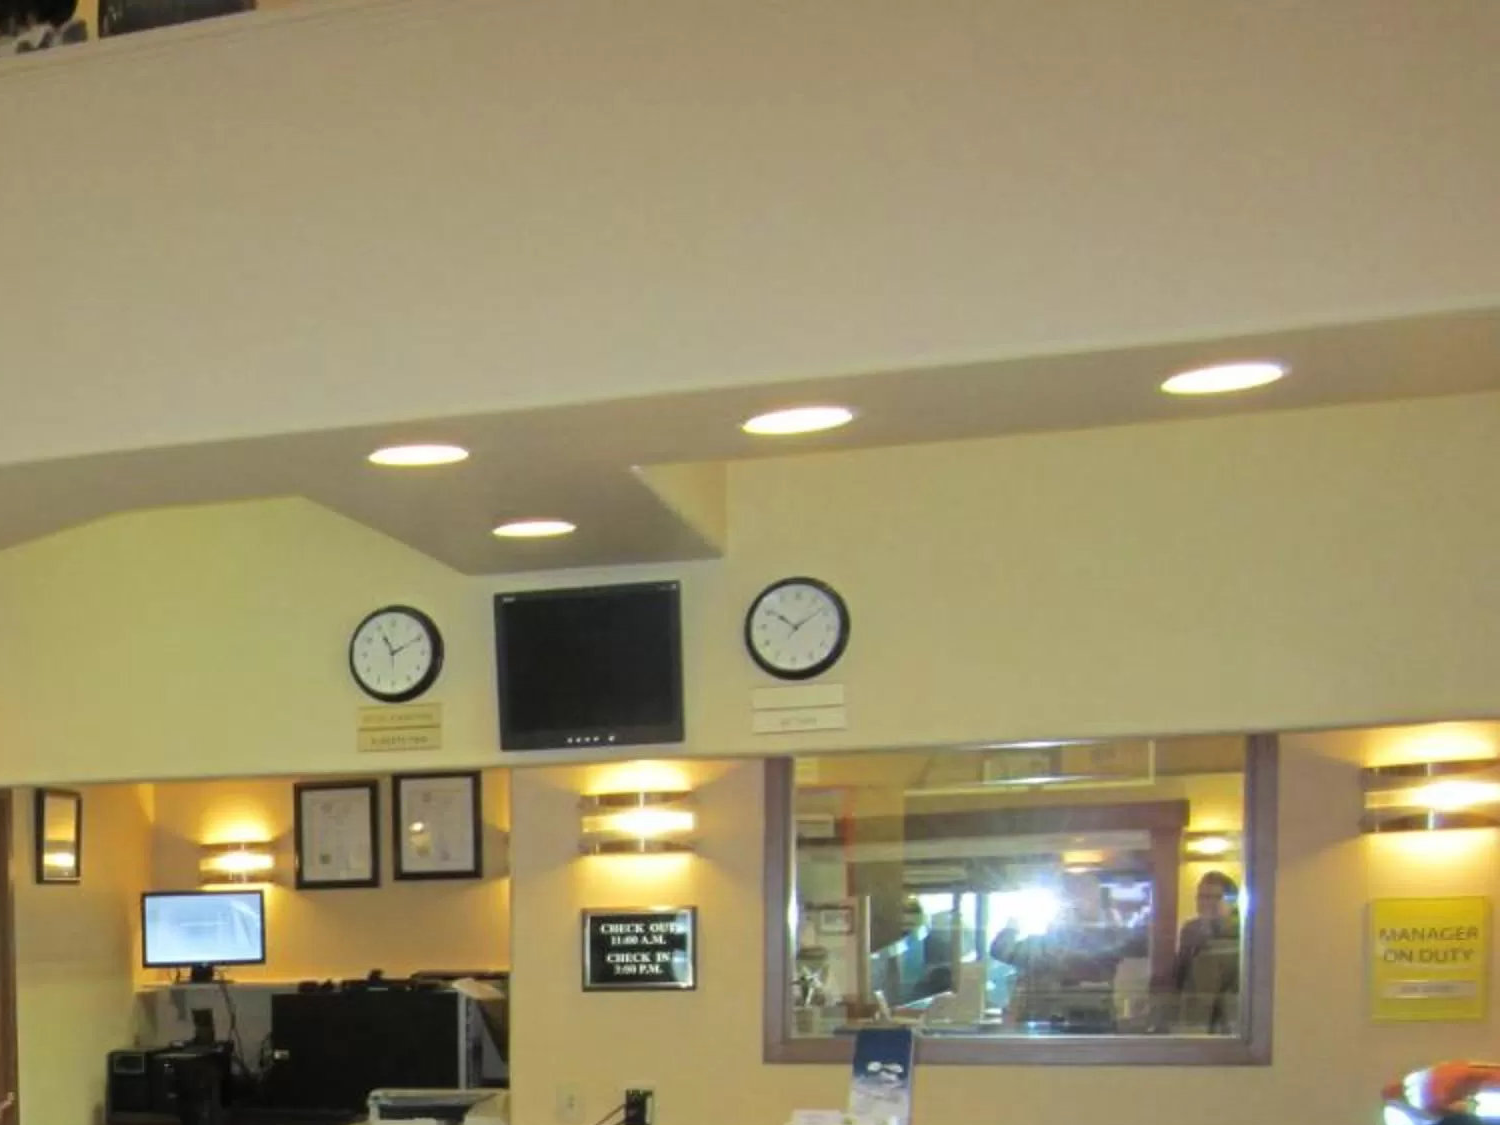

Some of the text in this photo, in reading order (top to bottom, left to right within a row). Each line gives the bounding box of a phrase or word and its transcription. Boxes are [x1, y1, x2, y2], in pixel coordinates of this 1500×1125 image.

[601, 923, 645, 934] CHECK
[1379, 926, 1479, 941] MANAGER
[607, 952, 671, 963] CHECK IN
[1383, 947, 1475, 964] ON DUTY
